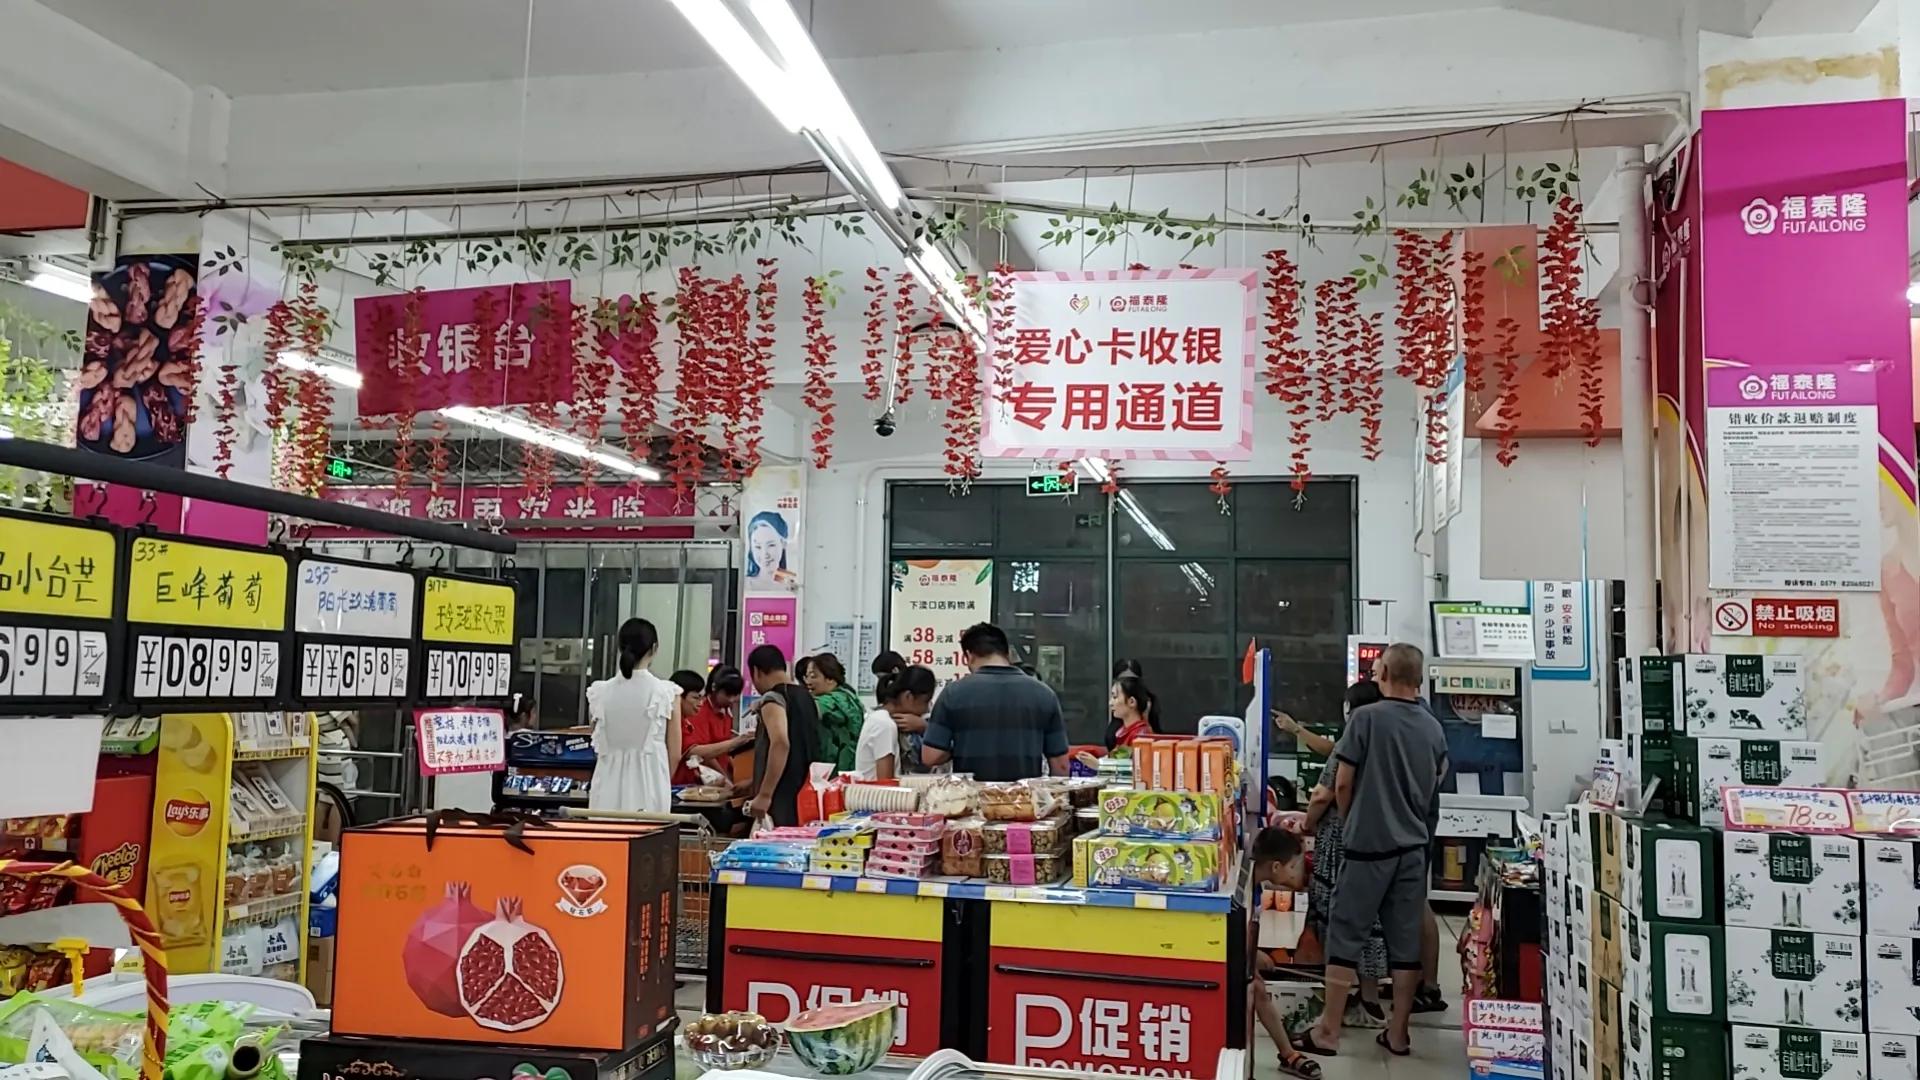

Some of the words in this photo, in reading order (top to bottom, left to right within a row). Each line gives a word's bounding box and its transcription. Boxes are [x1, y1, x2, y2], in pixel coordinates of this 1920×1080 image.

[1781, 193, 1868, 219] 福泰隆
[1782, 218, 1866, 234] FUTAILONG
[1129, 294, 1168, 306] 福泰隆
[1014, 327, 1222, 365] 爱心卡收银
[1770, 373, 1837, 390] 福泰隆
[1771, 390, 1836, 400] FUTAILONG
[1007, 381, 1223, 432] 专用通道
[1728, 412, 1857, 424] 错收价款退赔制度
[340, 495, 644, 530] 迎您再次光临
[135, 542, 168, 561] 33#
[931, 574, 957, 583] 福泰隆
[156, 565, 262, 613] 巨峰葡萄
[1544, 582, 1555, 614] 防一步
[1755, 604, 1836, 622] 禁止吸烟
[1562, 604, 1572, 645] 安全保险
[1784, 623, 1833, 631] smoking
[752, 630, 766, 645] 贴
[1545, 618, 1555, 660] 少出事故
[167, 804, 189, 820] Lay's
[189, 806, 209, 820] 乐事
[1784, 804, 1838, 826] 78.00
[1079, 998, 1191, 1062] 促销
